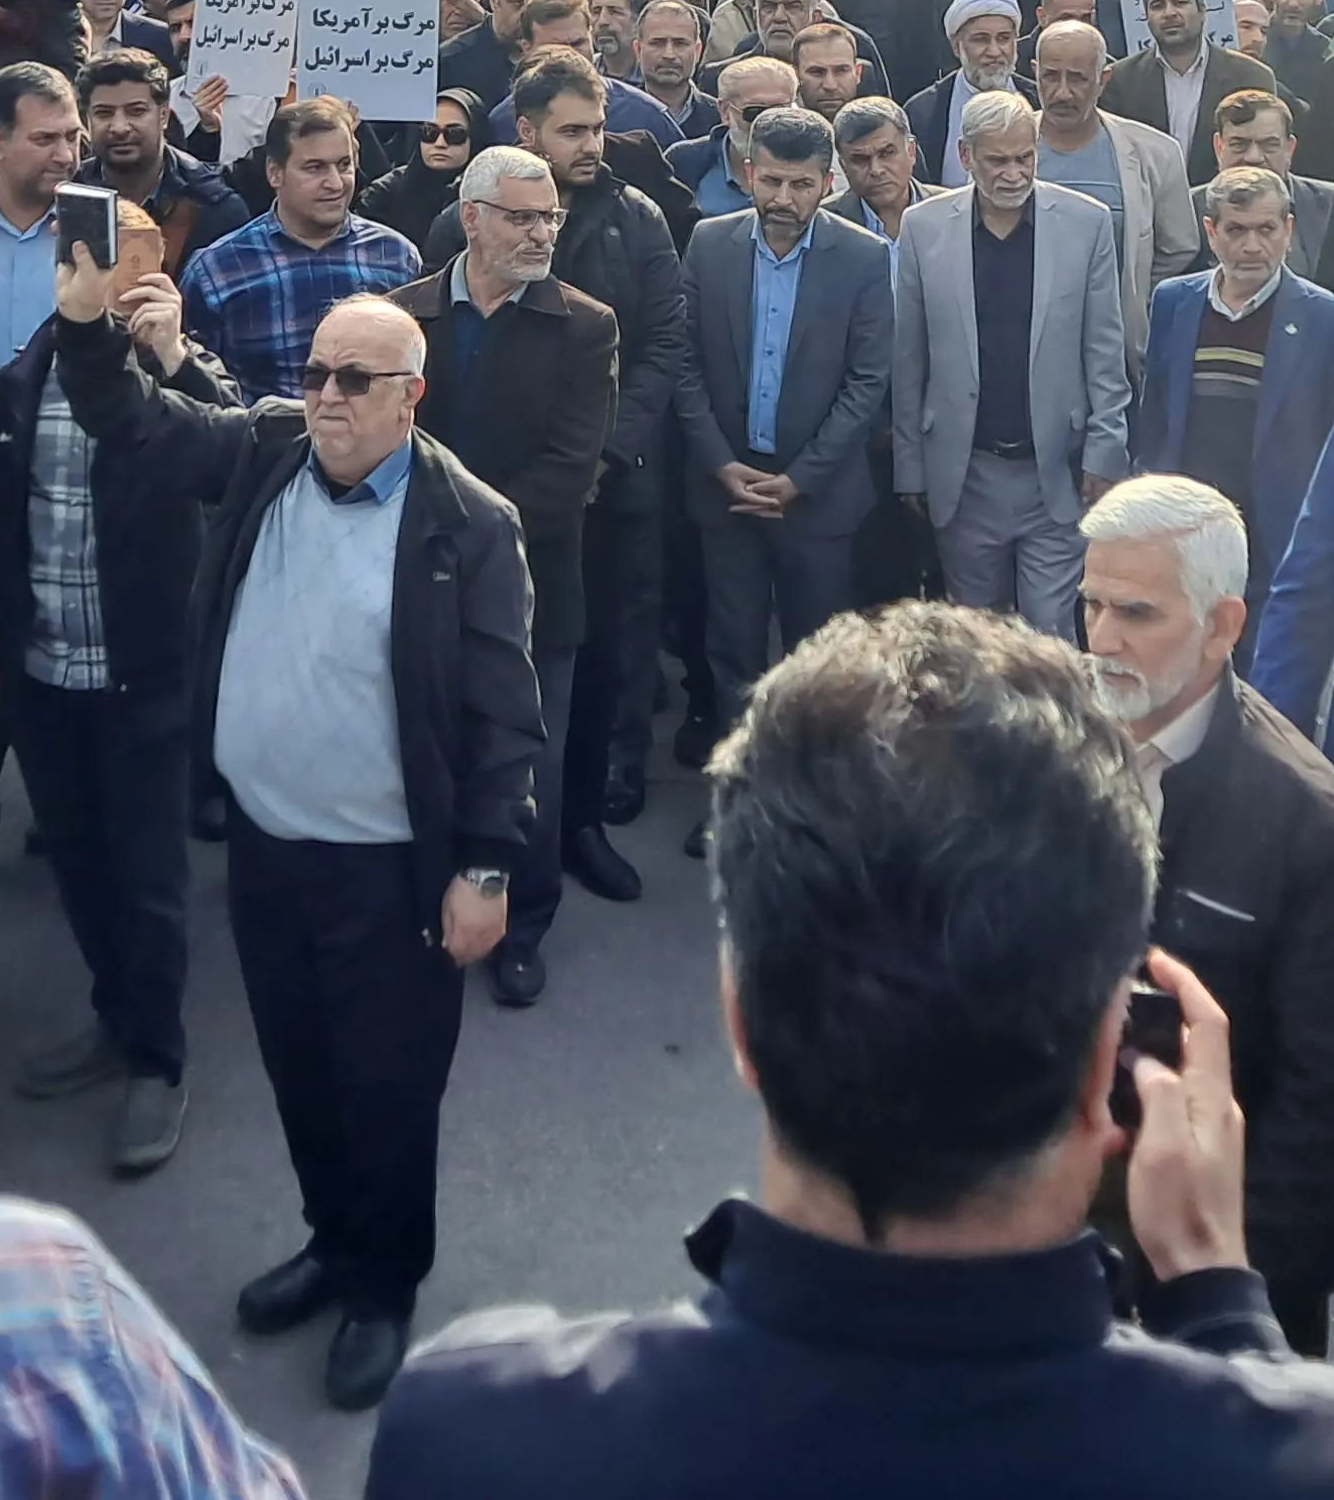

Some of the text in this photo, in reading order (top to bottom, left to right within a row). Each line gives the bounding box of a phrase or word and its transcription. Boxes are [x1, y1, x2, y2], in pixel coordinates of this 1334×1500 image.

[312, 7, 373, 34] آمریکا
[392, 11, 436, 36] مرگ
[195, 24, 245, 50] اسرائیل
[257, 29, 291, 53] مرگ
[304, 45, 371, 74] اسرائیل
[391, 49, 435, 75] مرگ
